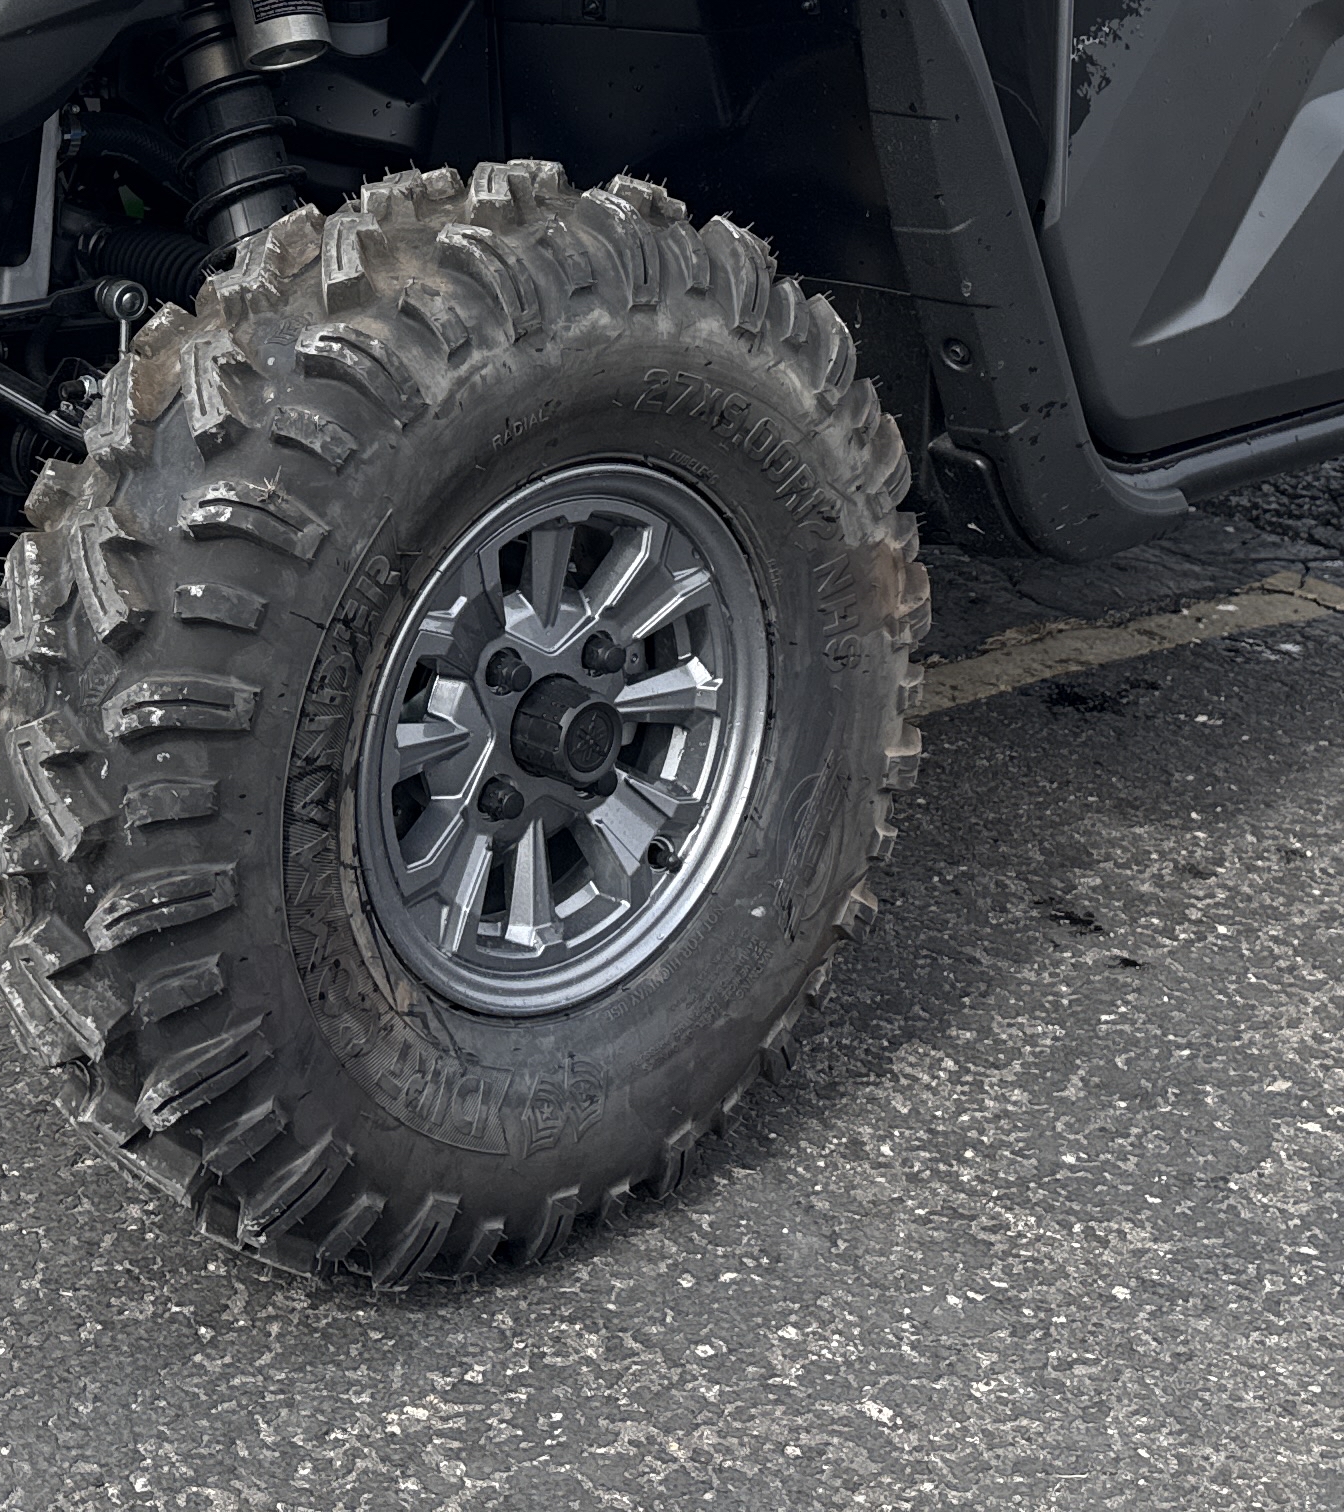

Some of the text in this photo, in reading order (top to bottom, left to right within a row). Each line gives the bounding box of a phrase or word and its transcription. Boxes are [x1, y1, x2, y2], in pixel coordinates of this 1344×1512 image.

[491, 408, 549, 451] RADIAL
[289, 554, 404, 1058] COMMANDER
[678, 929, 705, 958] FOR
[604, 1001, 629, 1021] USE
